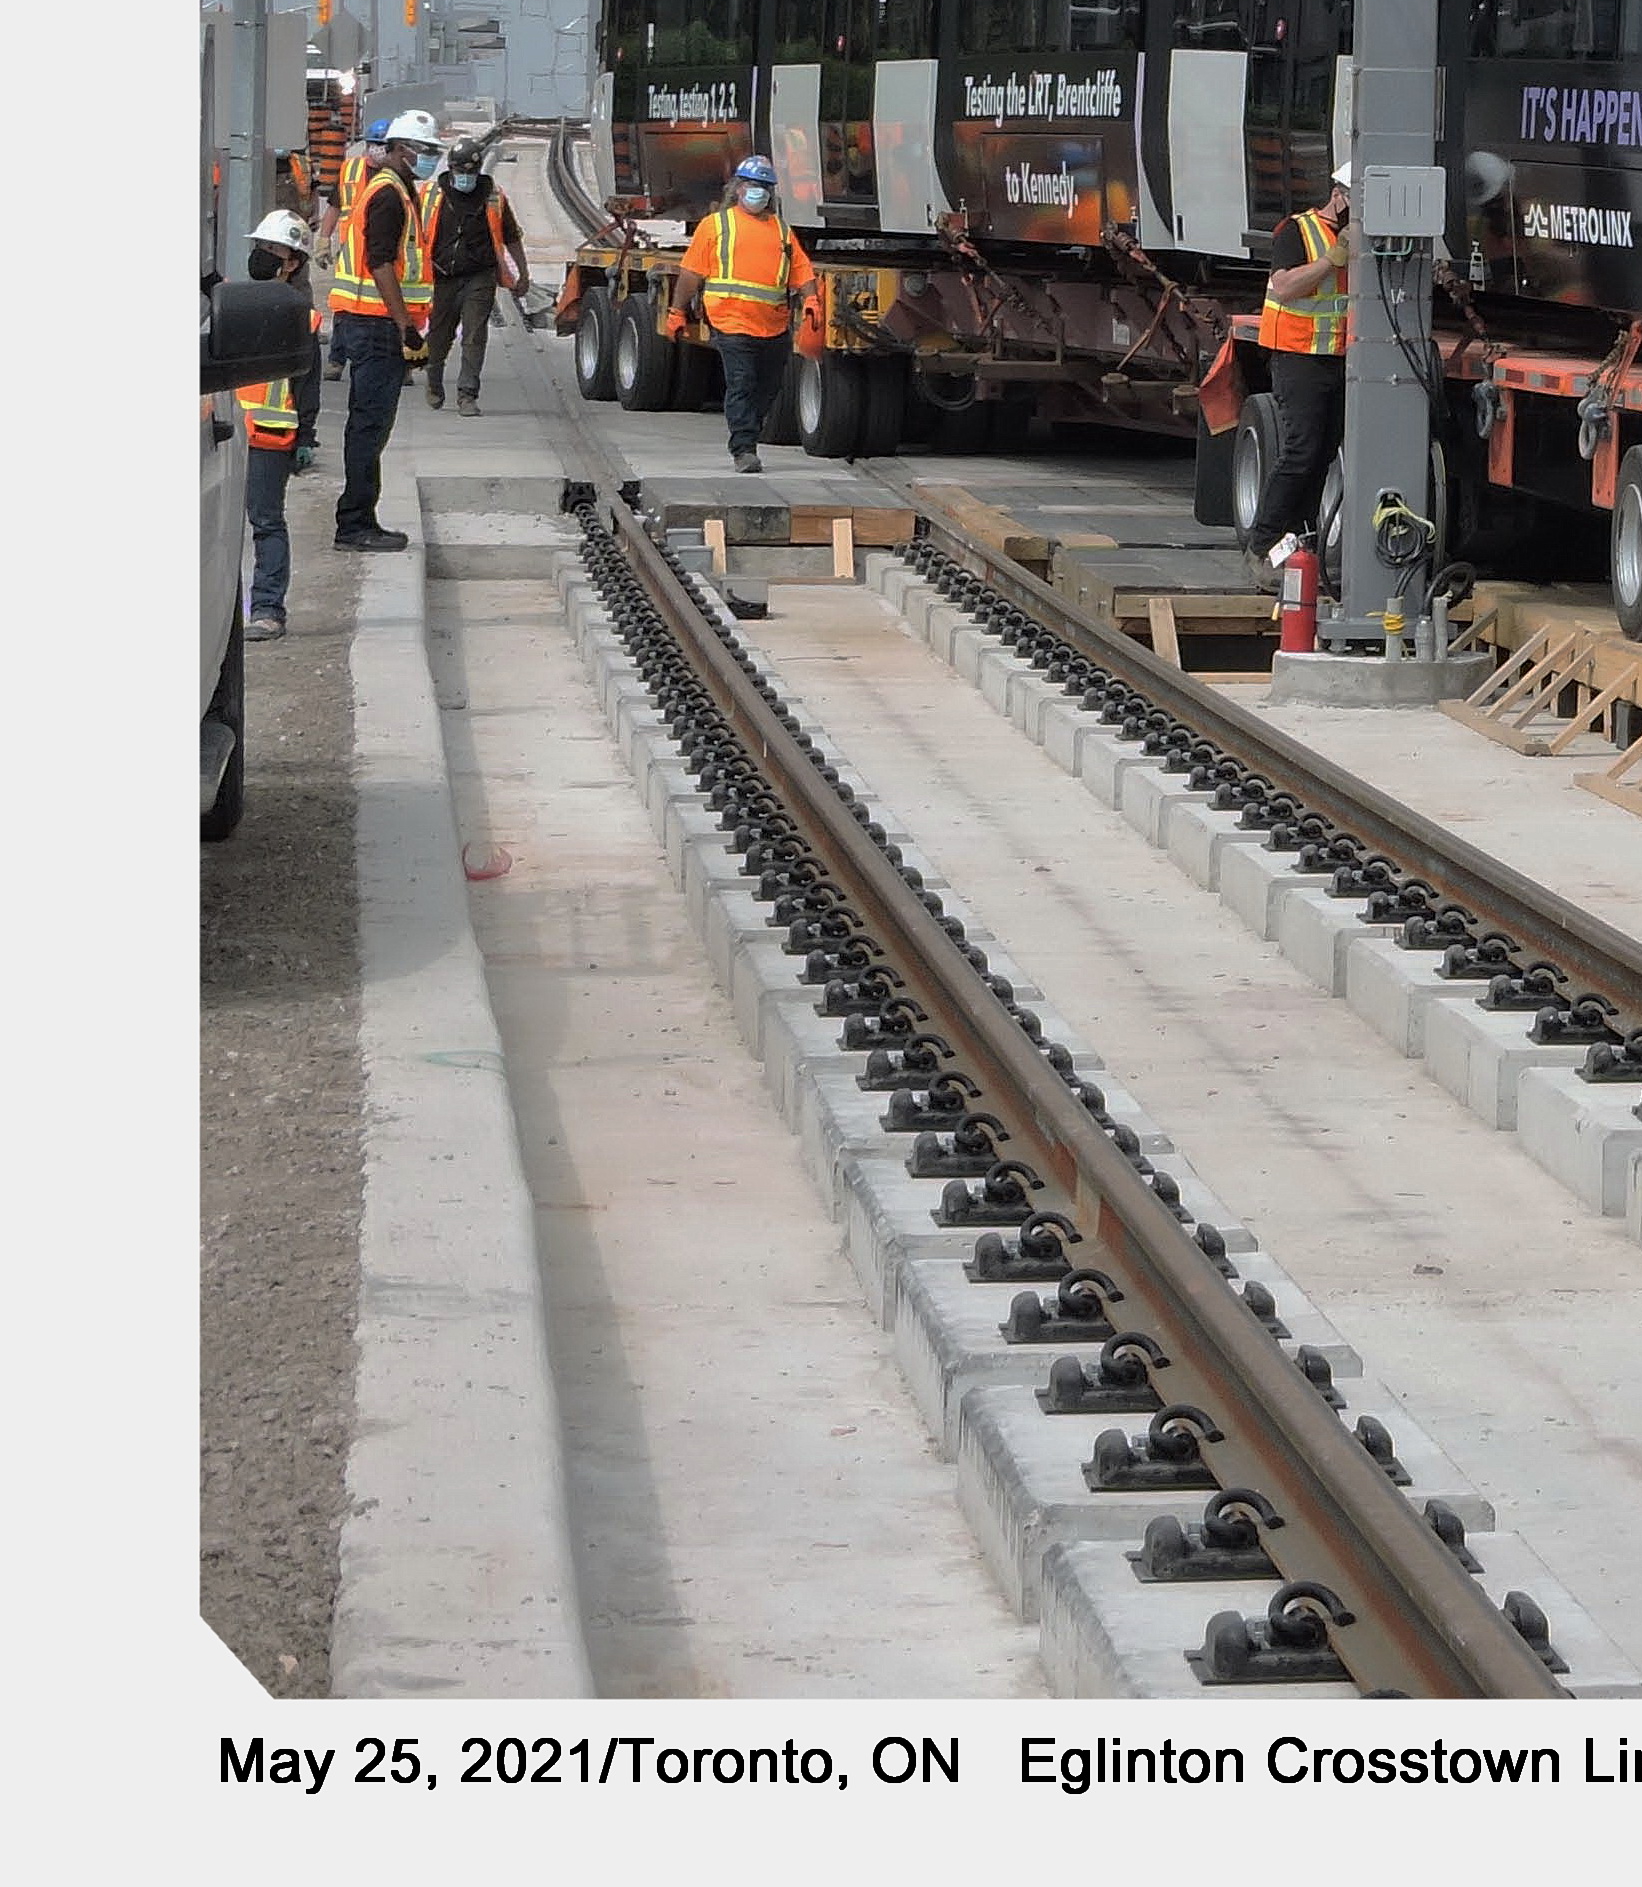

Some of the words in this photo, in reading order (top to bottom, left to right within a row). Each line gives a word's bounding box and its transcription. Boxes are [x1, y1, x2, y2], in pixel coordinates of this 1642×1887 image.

[648, 83, 678, 128] Testing,
[680, 82, 709, 128] testing
[964, 74, 1005, 128] Testing
[1006, 71, 1025, 116] the
[1028, 73, 1054, 123] LRT,
[1056, 69, 1122, 117] Brentcliffe
[1520, 86, 1558, 142] IT'S
[1005, 165, 1020, 204] to
[1021, 161, 1079, 219] Kennedy.
[1550, 204, 1634, 248] METROLINX
